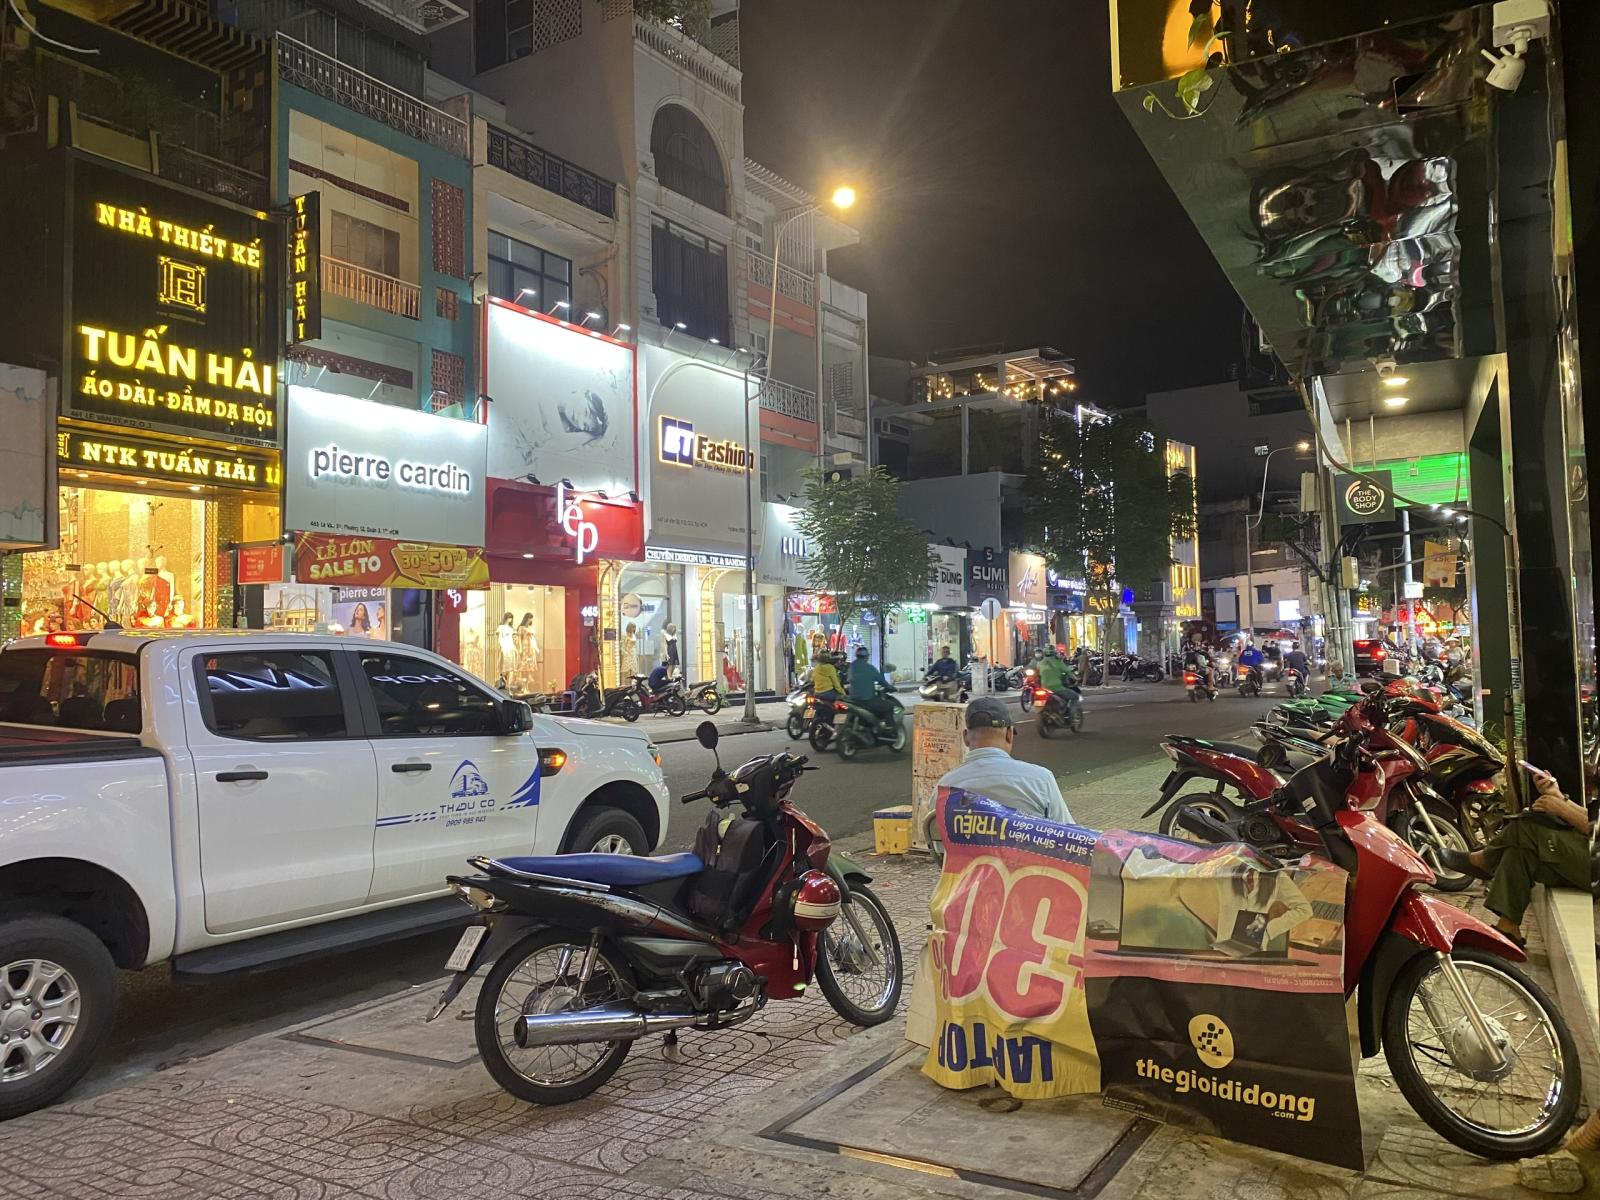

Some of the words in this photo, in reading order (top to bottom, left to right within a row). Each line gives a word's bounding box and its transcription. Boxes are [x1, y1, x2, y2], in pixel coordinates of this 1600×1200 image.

[98, 203, 153, 238] NHÀ
[159, 224, 226, 259] THIẾT
[231, 238, 261, 268] KẾ
[80, 325, 197, 380] TUẤN
[207, 348, 273, 395] HẢI
[83, 370, 113, 397] ÁO
[119, 379, 156, 406] DÀI
[168, 385, 211, 417] ĐẦM
[215, 401, 239, 426] DẠ
[243, 402, 272, 431] HỘI
[664, 425, 694, 457] BT
[697, 435, 754, 469] Fashion
[82, 441, 137, 467] NTK
[143, 448, 210, 476] TUẤN
[214, 457, 256, 482] HẢI
[313, 446, 390, 480] pierre
[399, 463, 470, 492] cardin
[1355, 501, 1377, 509] SHOP
[310, 559, 354, 578] SALE
[359, 556, 381, 573] TO
[973, 566, 1005, 582] SUMI
[340, 587, 368, 601] pierre
[480, 799, 495, 808] CO
[953, 809, 997, 840] TRIỆU
[1008, 829, 1031, 843] viên
[1033, 837, 1056, 850] Sinh
[1068, 832, 1097, 846] Giảm
[1065, 843, 1088, 856] sinh
[1135, 1059, 1315, 1122] thegioididong
[1271, 1111, 1295, 1120] .com
